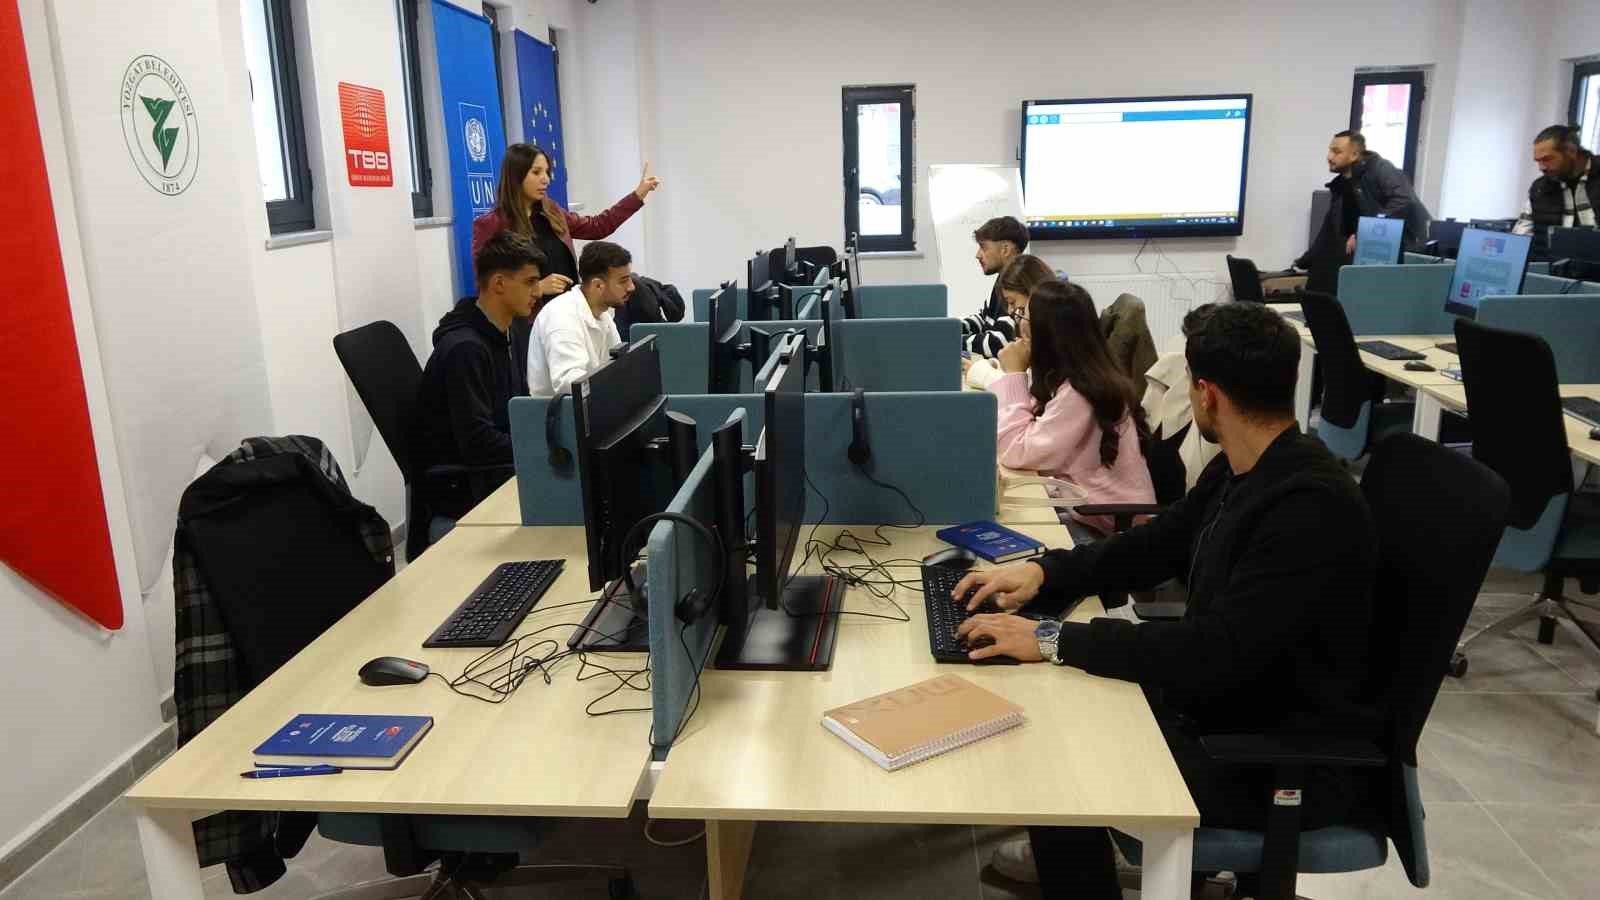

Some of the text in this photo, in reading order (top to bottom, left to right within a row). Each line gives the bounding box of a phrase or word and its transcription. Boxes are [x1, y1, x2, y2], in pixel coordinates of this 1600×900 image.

[123, 63, 144, 110] YOZGAT
[348, 149, 389, 170] TBB
[162, 181, 181, 193] 1874
[471, 179, 495, 205] UN
